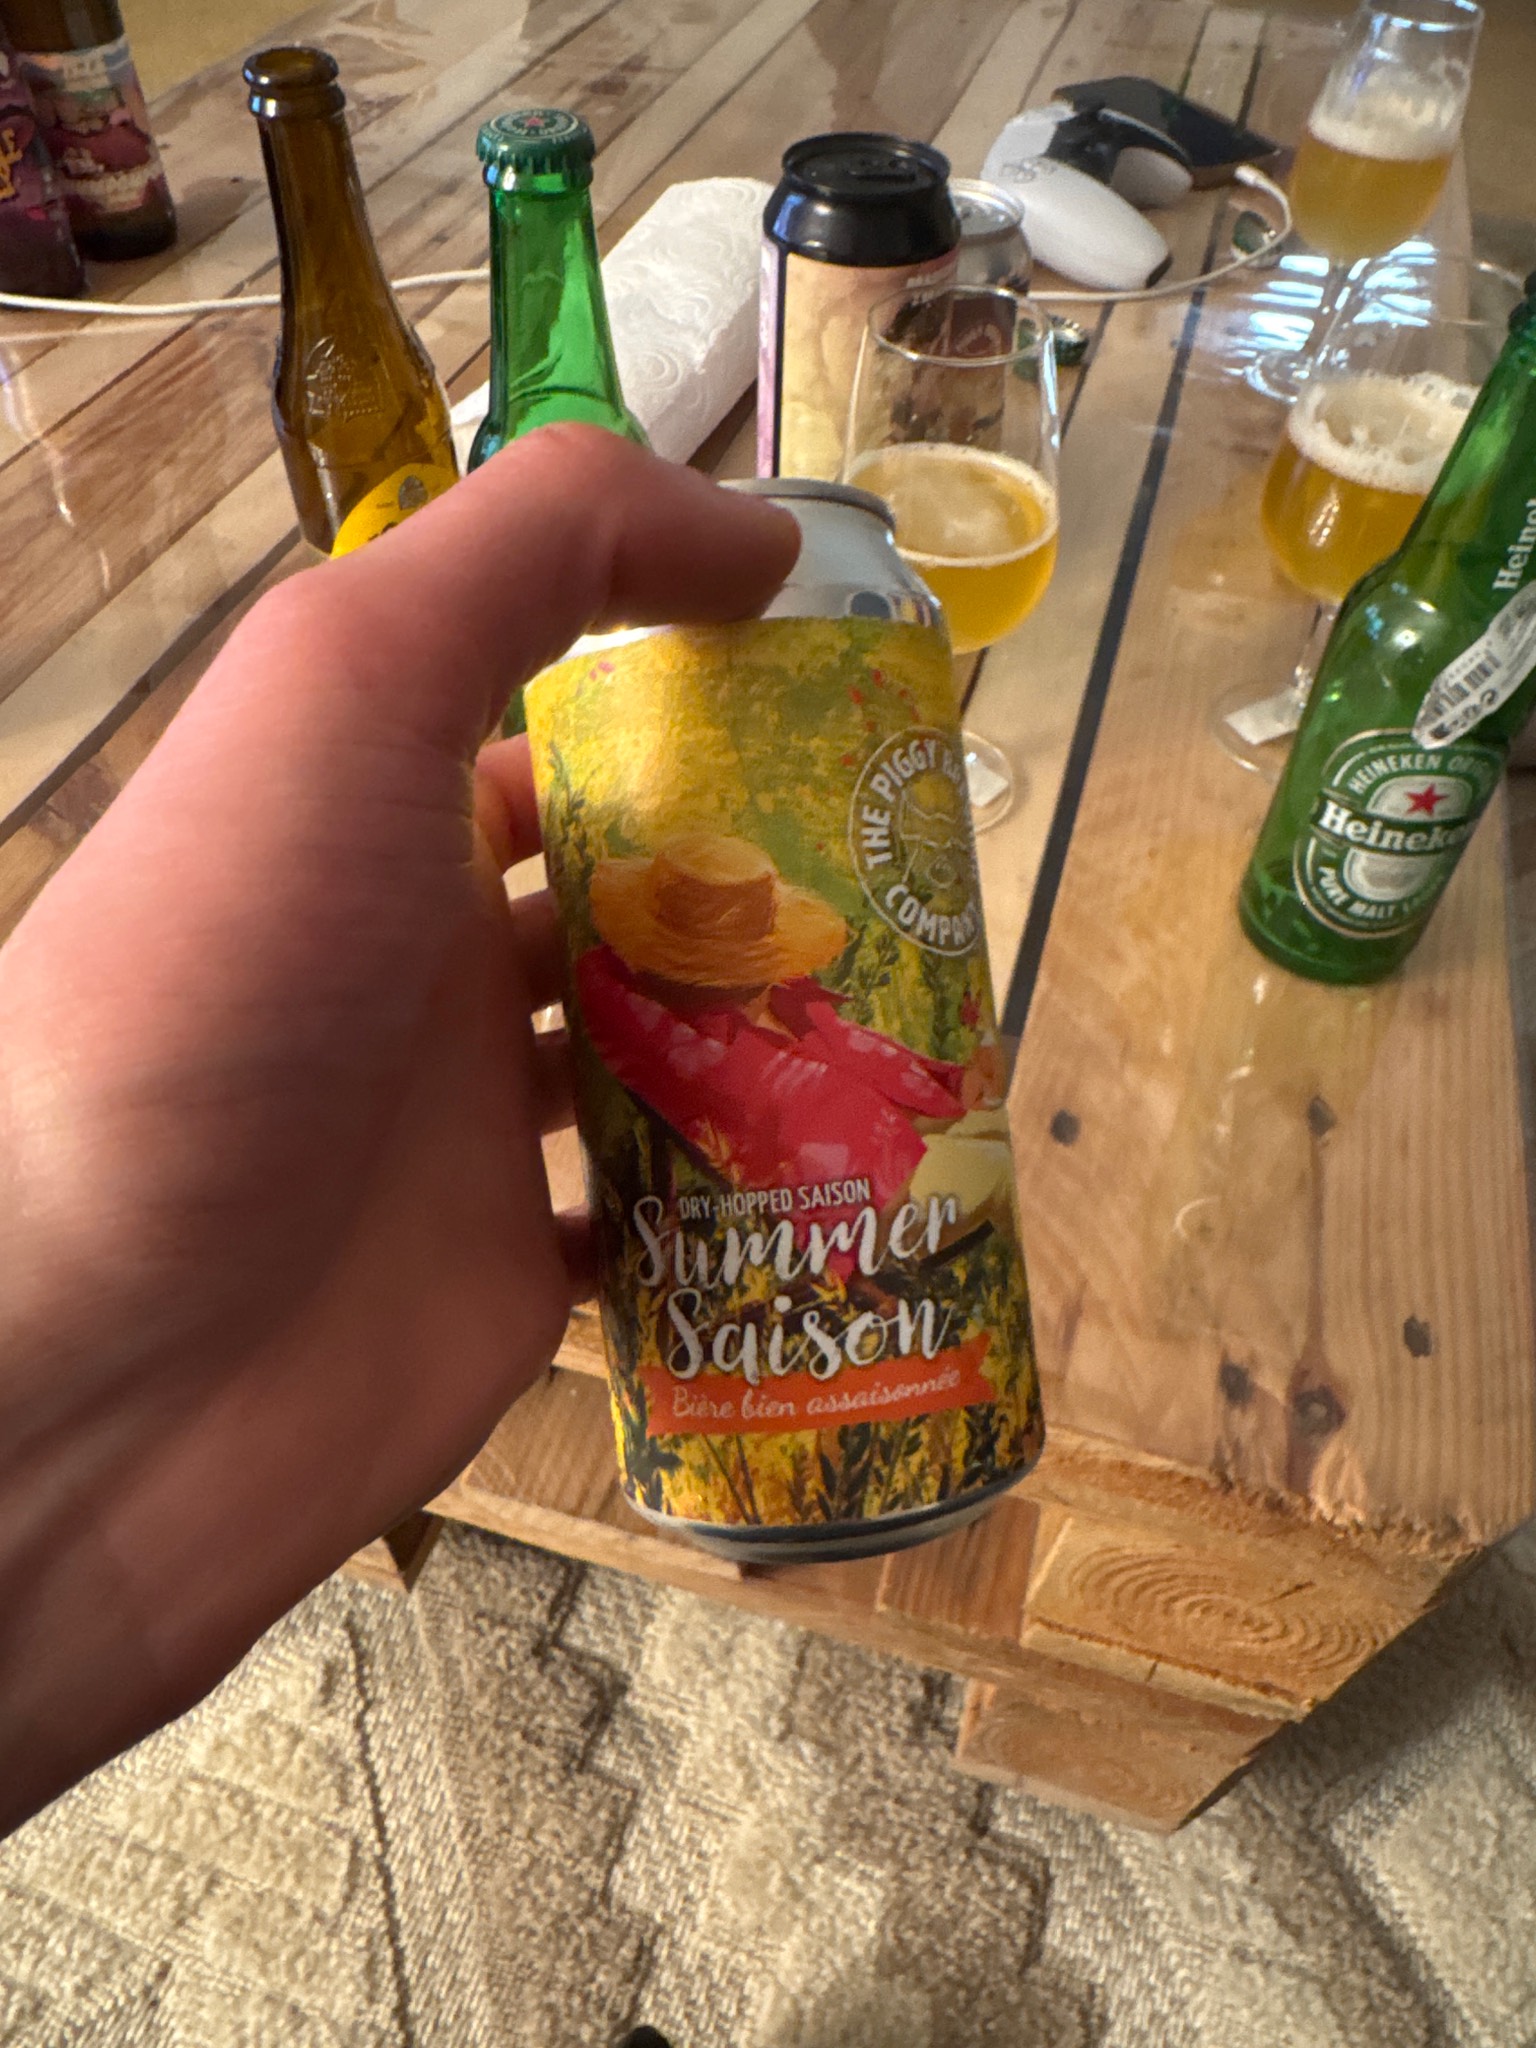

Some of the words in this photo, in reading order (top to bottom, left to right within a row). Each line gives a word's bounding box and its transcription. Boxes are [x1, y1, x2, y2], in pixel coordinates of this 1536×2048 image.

[869, 738, 937, 802] PIGGY
[1347, 752, 1442, 796] HEINEKEN
[861, 804, 893, 870] THE
[679, 1187, 793, 1220] DRY-HOPPED
[799, 1177, 870, 1210] SAISON
[632, 1195, 958, 1291] Summer
[666, 1287, 952, 1387] Saison
[672, 1384, 737, 1419] Bière
[740, 1386, 797, 1419] bien
[806, 1364, 962, 1414] assaisonnée
